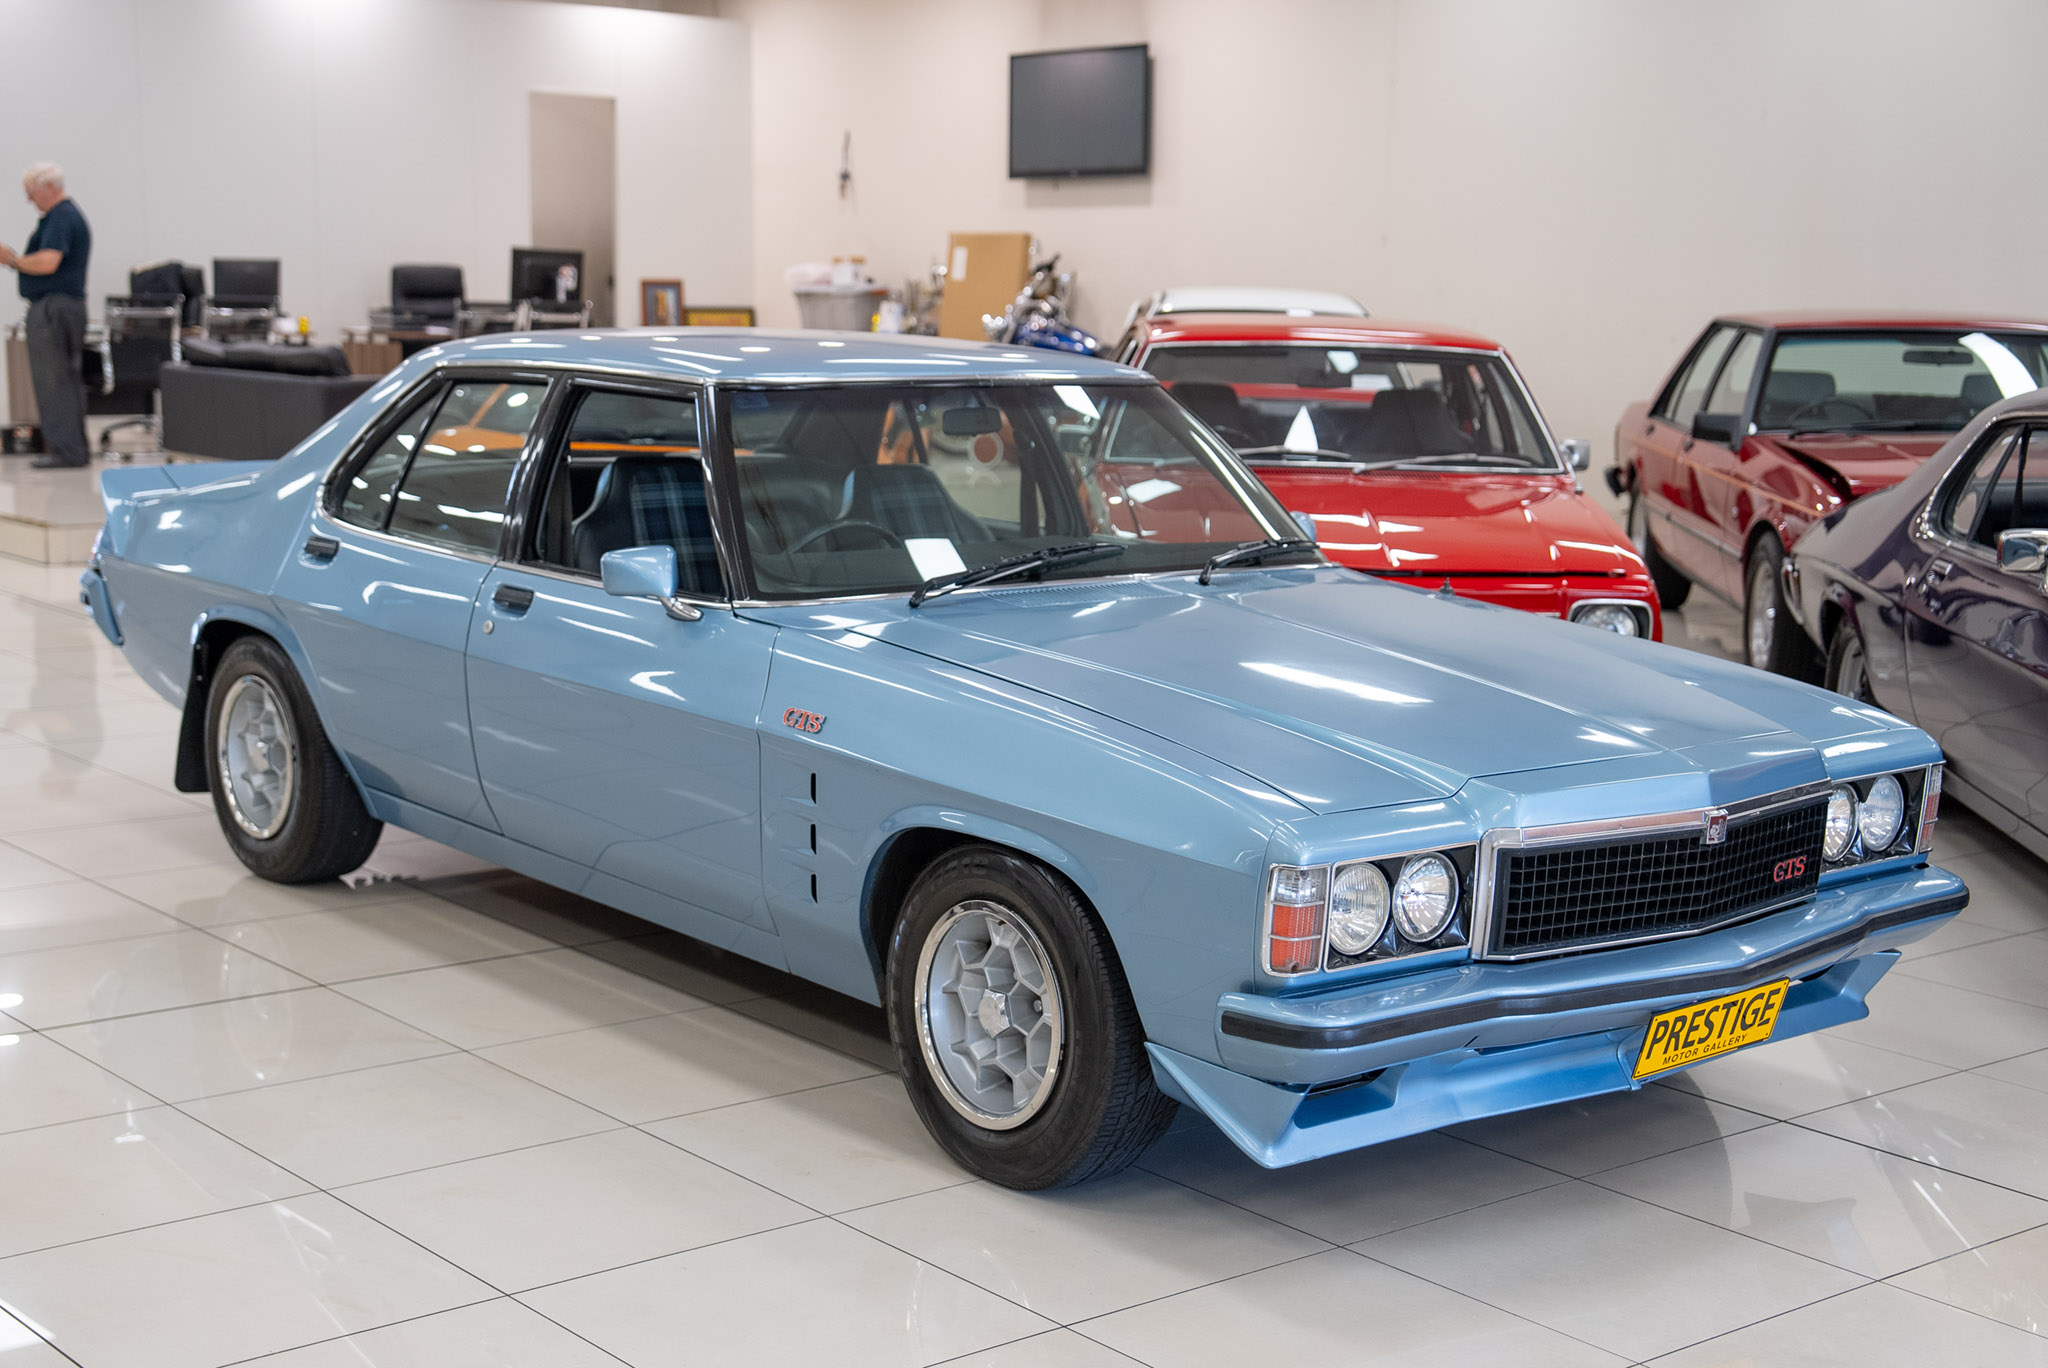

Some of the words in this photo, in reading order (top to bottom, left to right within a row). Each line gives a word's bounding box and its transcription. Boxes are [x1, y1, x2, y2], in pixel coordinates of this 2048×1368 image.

[783, 707, 824, 733] GTS
[1773, 855, 1807, 883] GTS
[1645, 987, 1782, 1061] PRESTIGE
[1662, 1047, 1699, 1066] MOTOR
[1703, 1033, 1748, 1053] GALLERY
